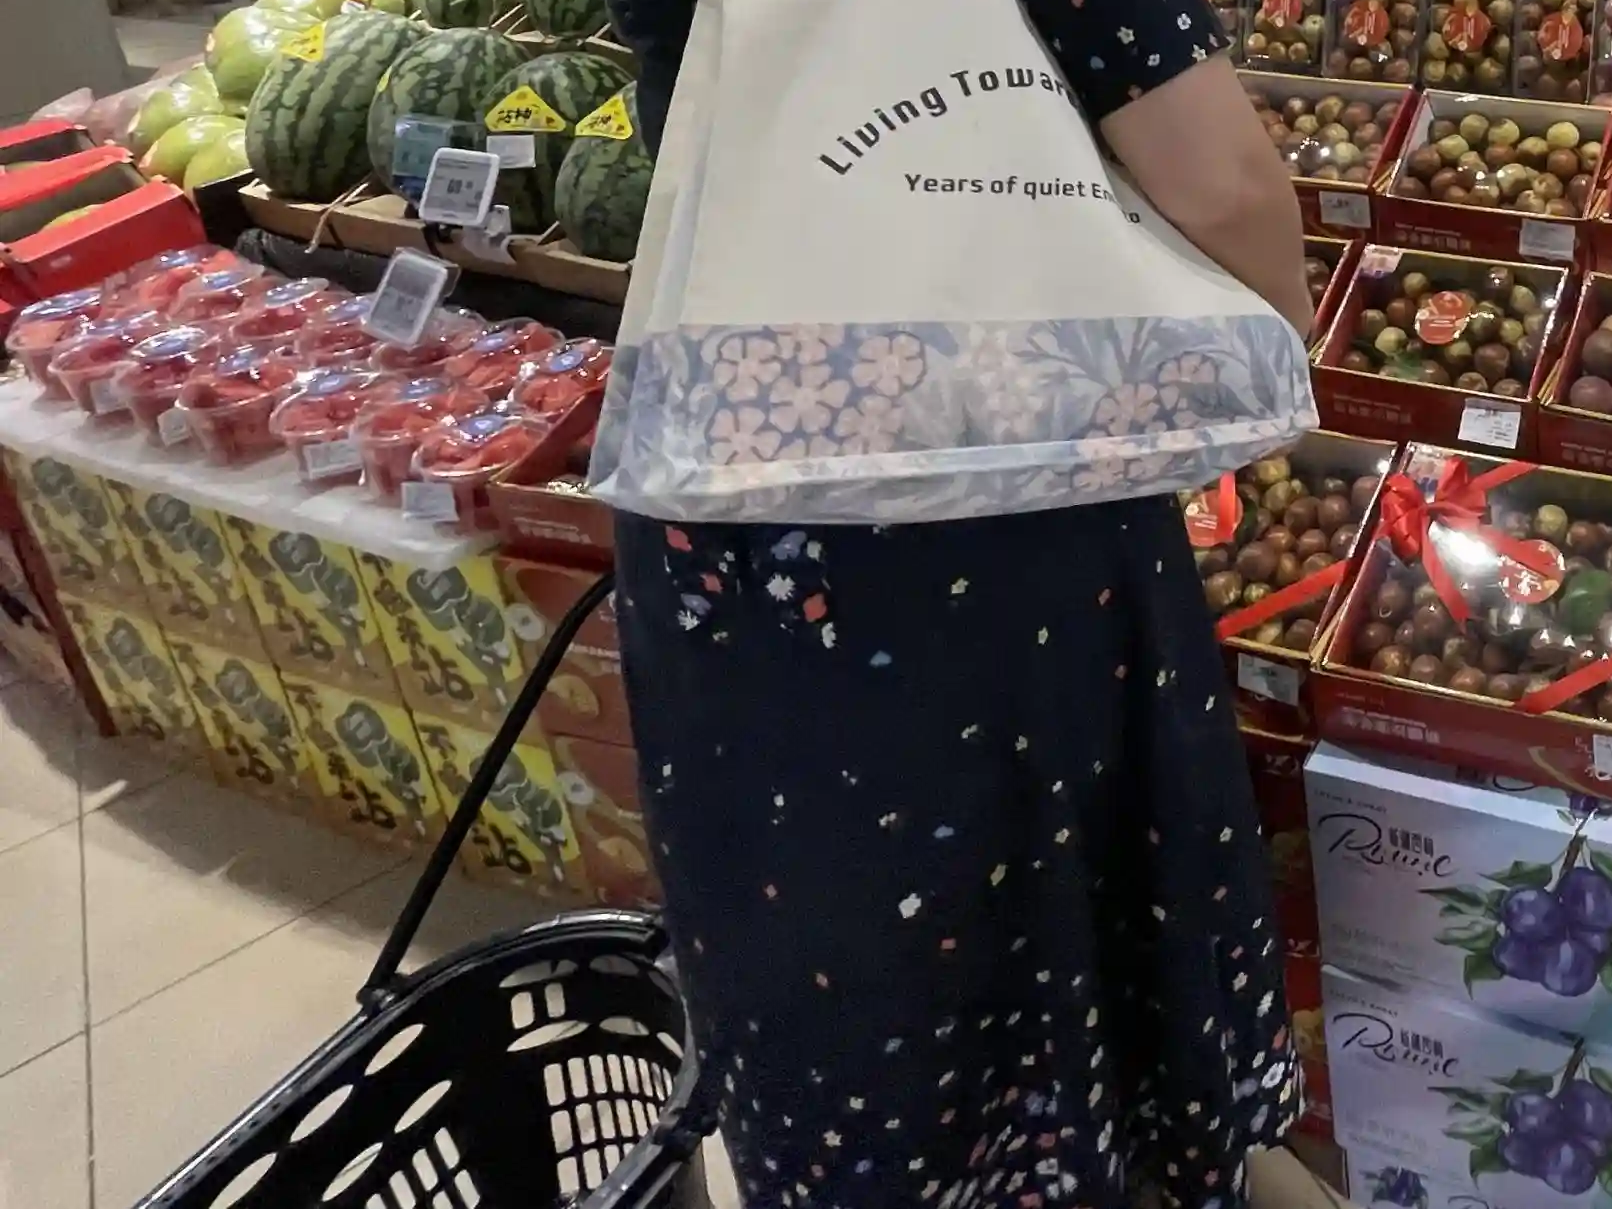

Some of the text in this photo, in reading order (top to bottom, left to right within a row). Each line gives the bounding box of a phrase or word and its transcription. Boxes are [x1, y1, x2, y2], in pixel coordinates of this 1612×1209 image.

[819, 87, 948, 175] Living
[905, 173, 984, 193] Years
[990, 176, 1017, 194] of
[1023, 180, 1087, 201] quiet
